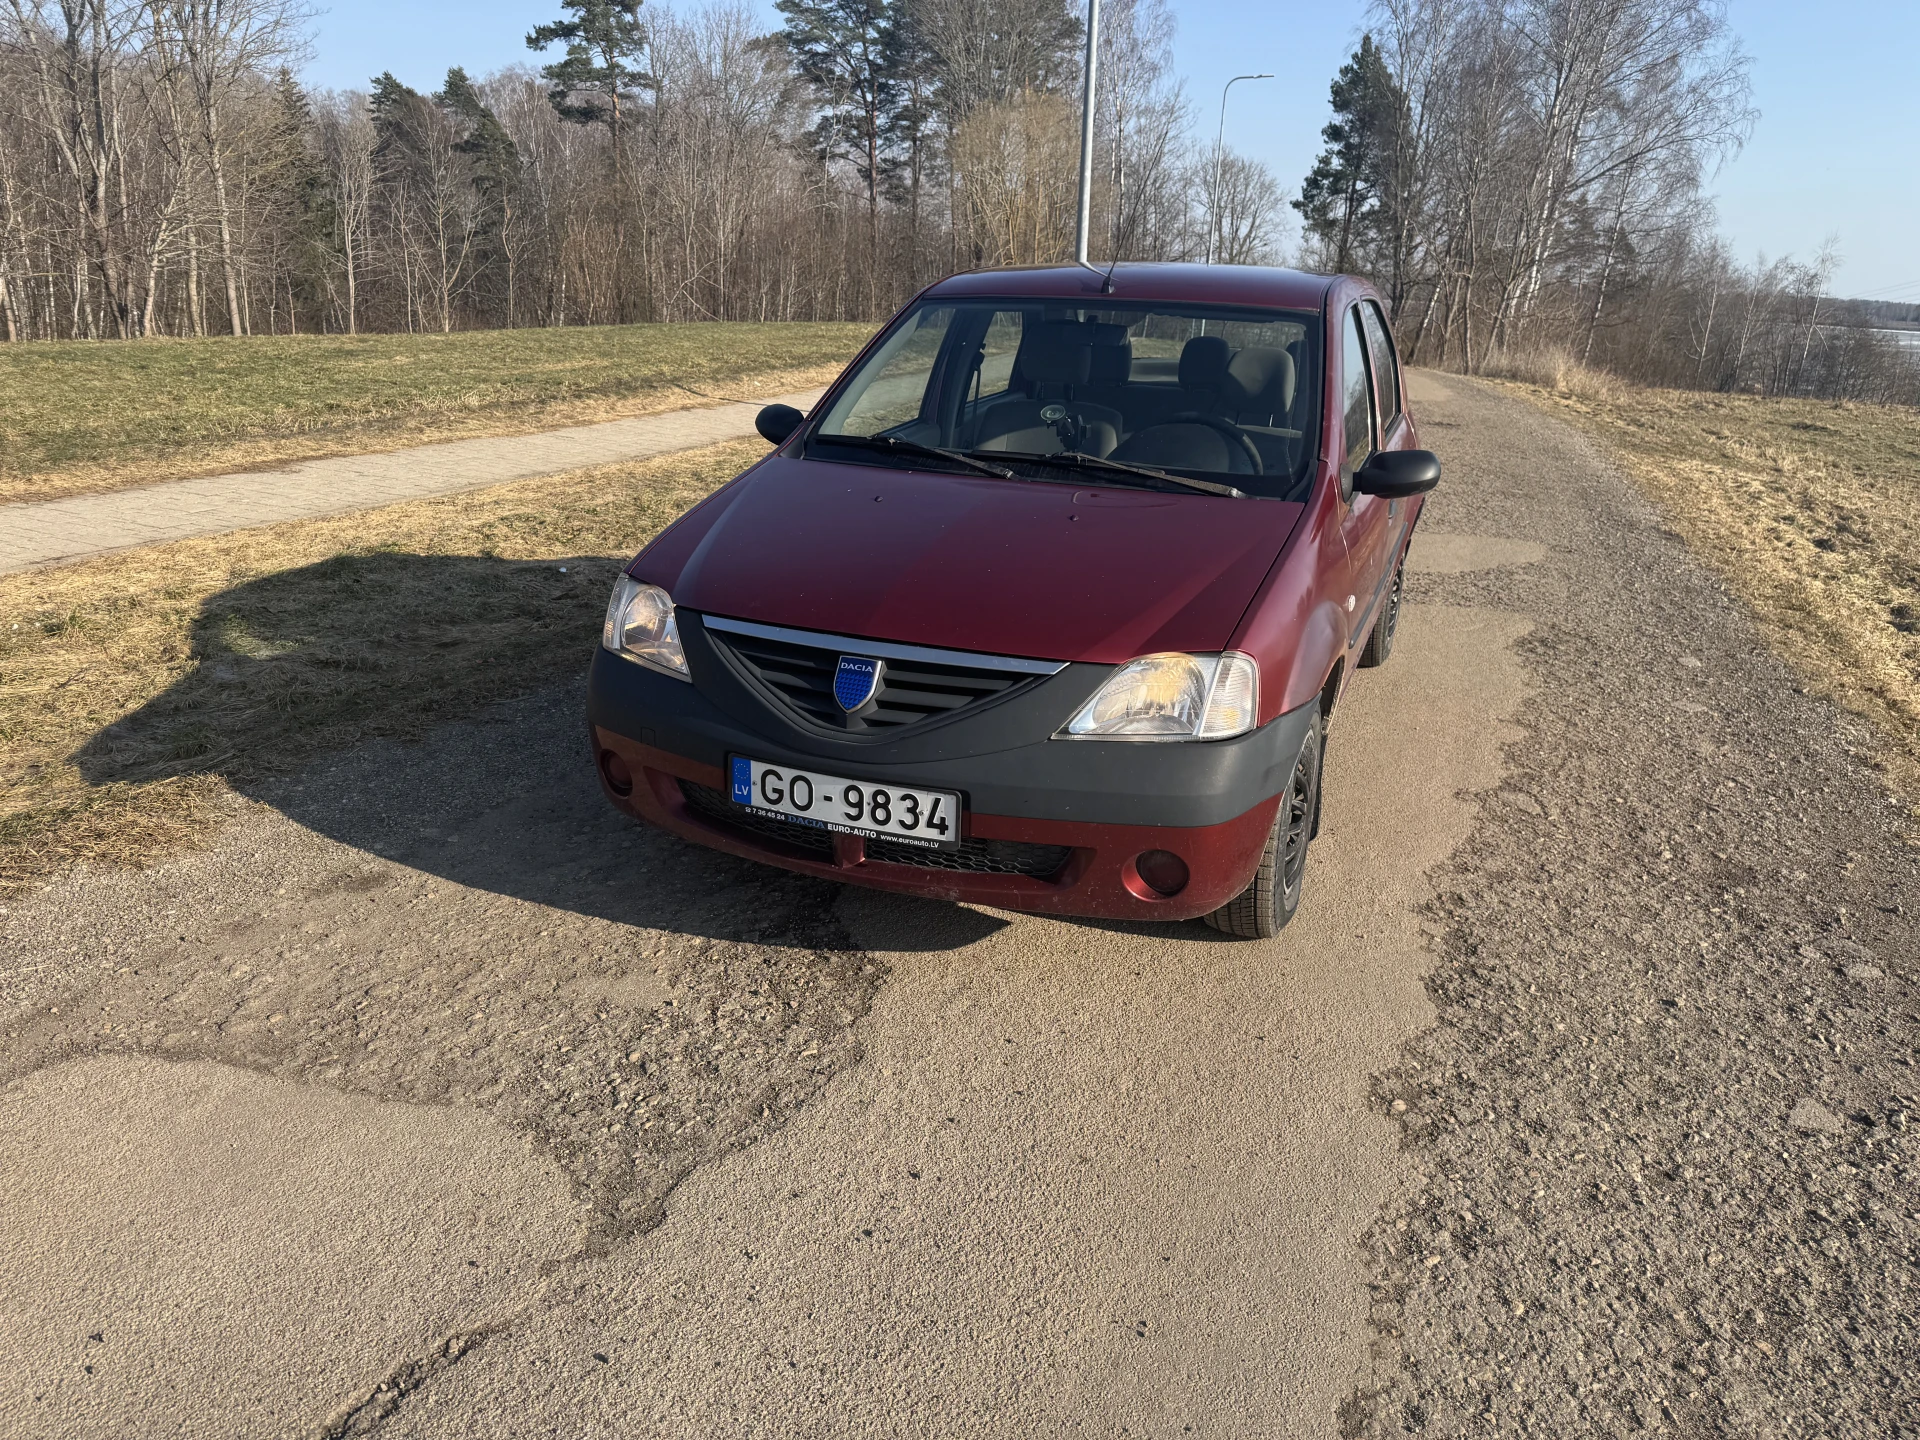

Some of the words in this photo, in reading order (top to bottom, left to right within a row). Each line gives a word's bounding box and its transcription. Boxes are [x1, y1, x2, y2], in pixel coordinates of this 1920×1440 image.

[841, 662, 873, 673] DACIA
[735, 783, 749, 796] LV
[760, 768, 949, 836] GO-9834
[787, 815, 825, 829] DACIA
[827, 823, 877, 838] EURO-AUTO
[880, 834, 940, 848] www.euroauto.LV
